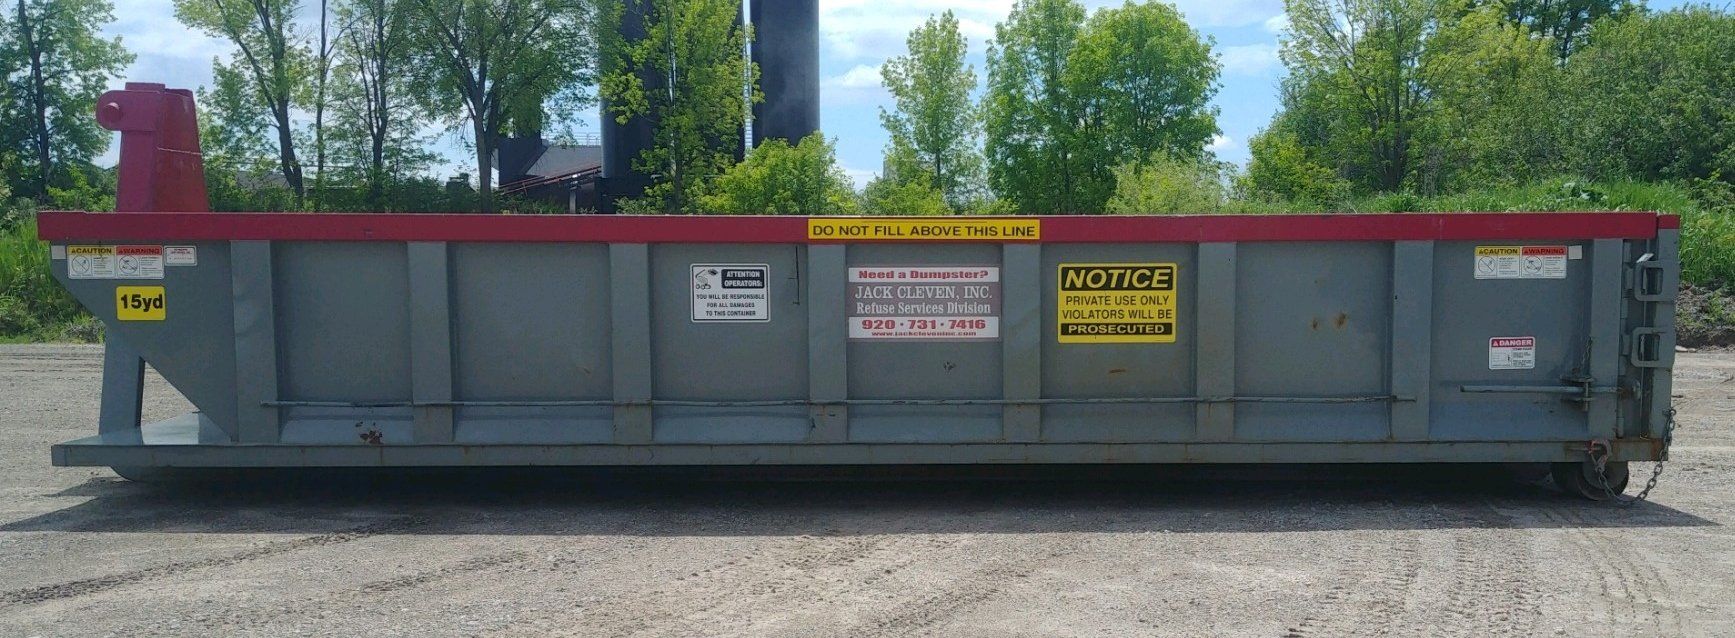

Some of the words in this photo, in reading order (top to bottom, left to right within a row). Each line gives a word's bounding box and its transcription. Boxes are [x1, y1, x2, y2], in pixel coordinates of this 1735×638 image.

[813, 225, 834, 236] DO
[839, 225, 869, 236] NOT
[874, 225, 905, 236] FILL
[910, 225, 961, 237] ABOVE
[965, 225, 998, 237] THIS
[1003, 226, 1035, 237] LINE
[859, 271, 895, 279] Need
[910, 270, 989, 280] Dumpster?
[1065, 269, 1171, 289] NOTICE
[855, 286, 894, 299] JACK
[897, 286, 960, 301] CLEVEN,
[963, 286, 993, 299] INC.
[121, 294, 163, 312] 15yd
[1066, 295, 1111, 306] PRIVATE
[1115, 295, 1137, 306] USE
[1140, 295, 1169, 306] ONLY
[856, 302, 895, 314] Refuse
[897, 302, 944, 314] Services
[947, 302, 991, 314] Division
[1062, 309, 1124, 320] VIOLATORS
[1128, 309, 1154, 320] WILL
[1158, 309, 1172, 319] BE
[862, 320, 896, 330] 920
[908, 320, 936, 330] 731
[949, 320, 986, 330] 7416
[1068, 324, 1165, 334] PROSECUTED
